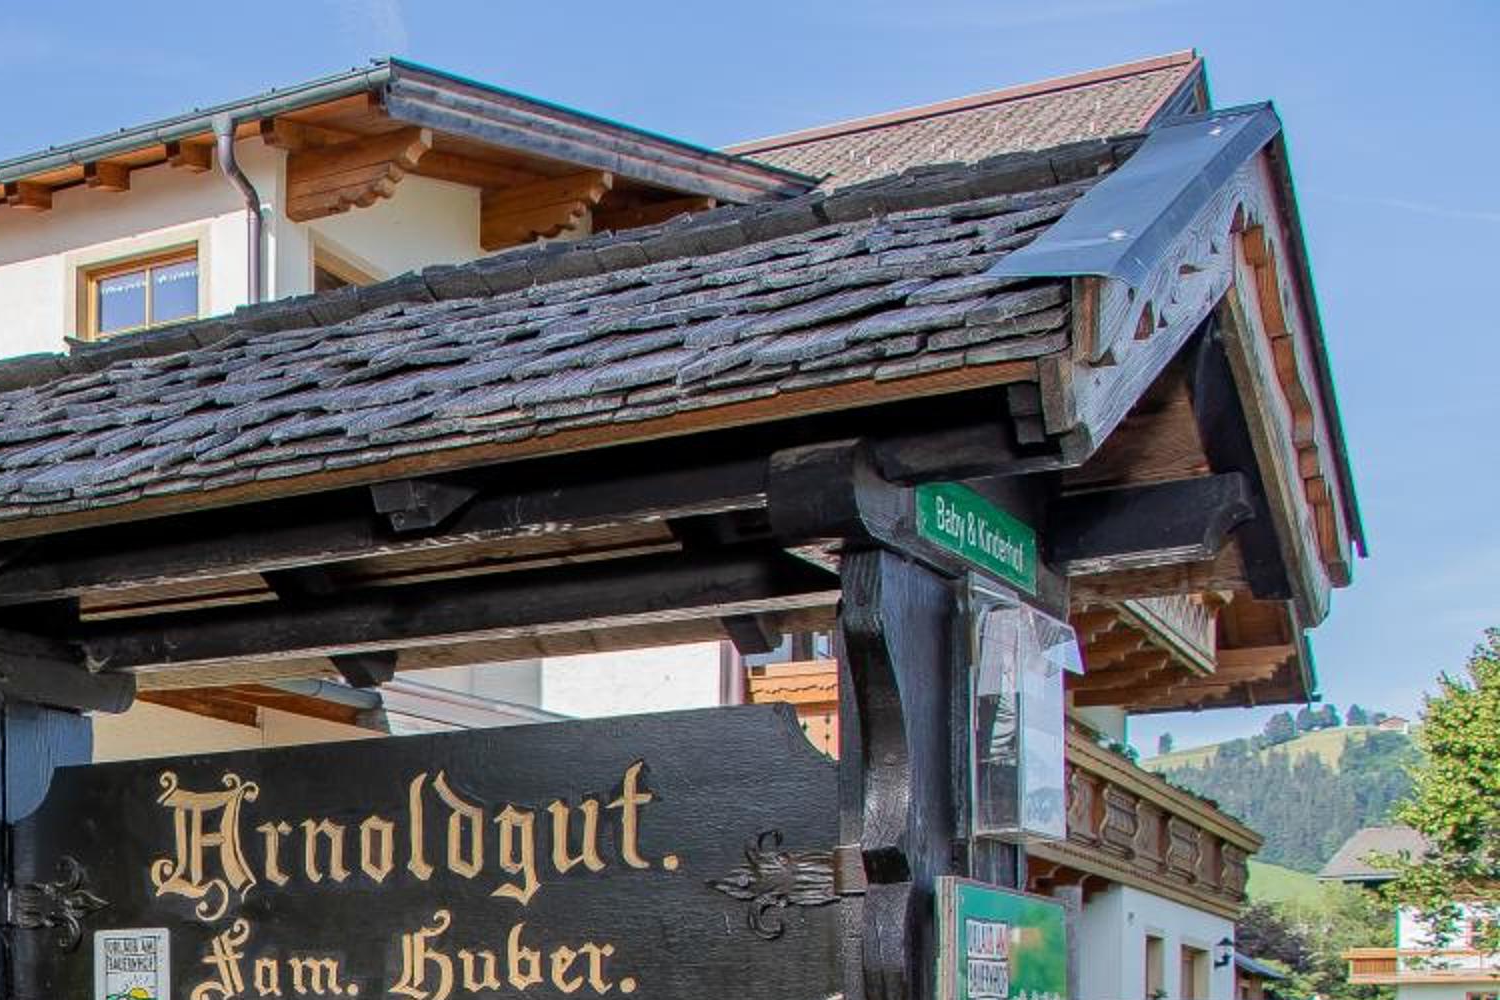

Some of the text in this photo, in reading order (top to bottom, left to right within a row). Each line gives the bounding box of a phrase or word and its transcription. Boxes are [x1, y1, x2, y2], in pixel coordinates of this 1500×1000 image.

[935, 495, 964, 549] Baby
[967, 511, 978, 547] &
[151, 760, 681, 921] Arnoldgut.
